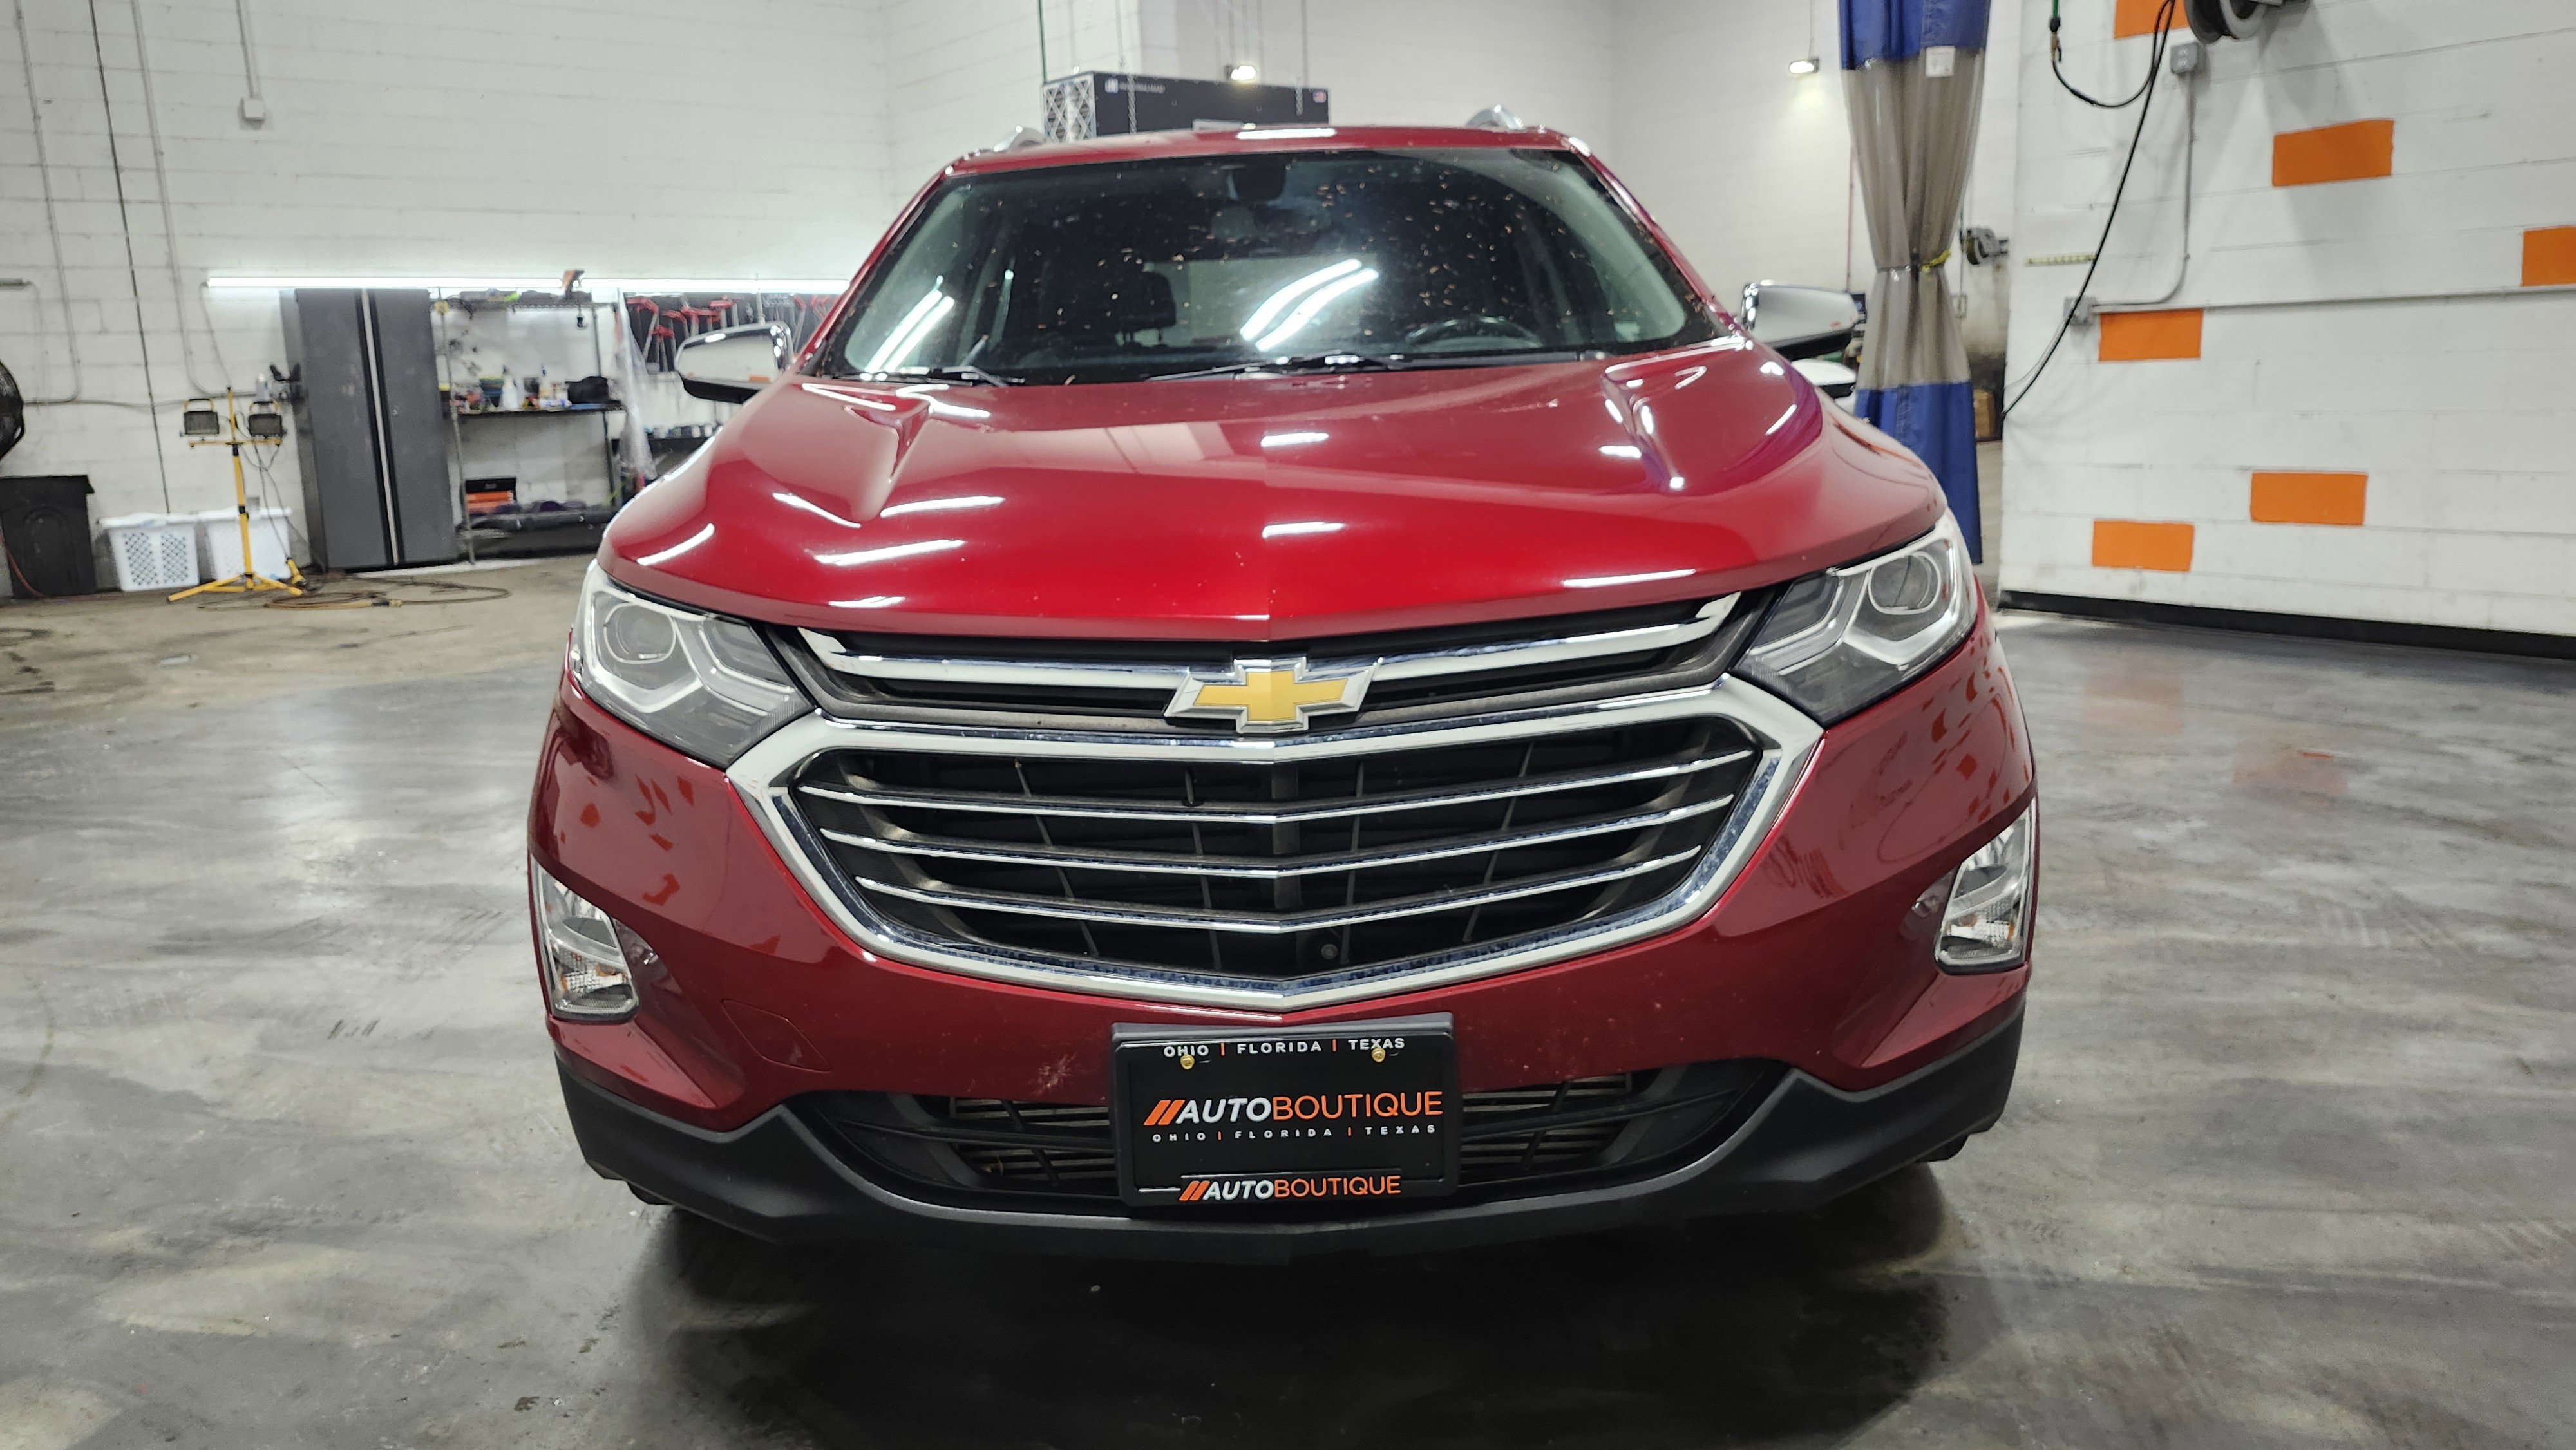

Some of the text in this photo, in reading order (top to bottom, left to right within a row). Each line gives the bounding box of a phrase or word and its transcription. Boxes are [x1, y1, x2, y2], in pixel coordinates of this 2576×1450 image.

[1163, 1037, 1405, 1058] OHIO FLORIDA TEXAS
[1152, 1124, 1435, 1143] OHIO FLORIDA TEXAS
